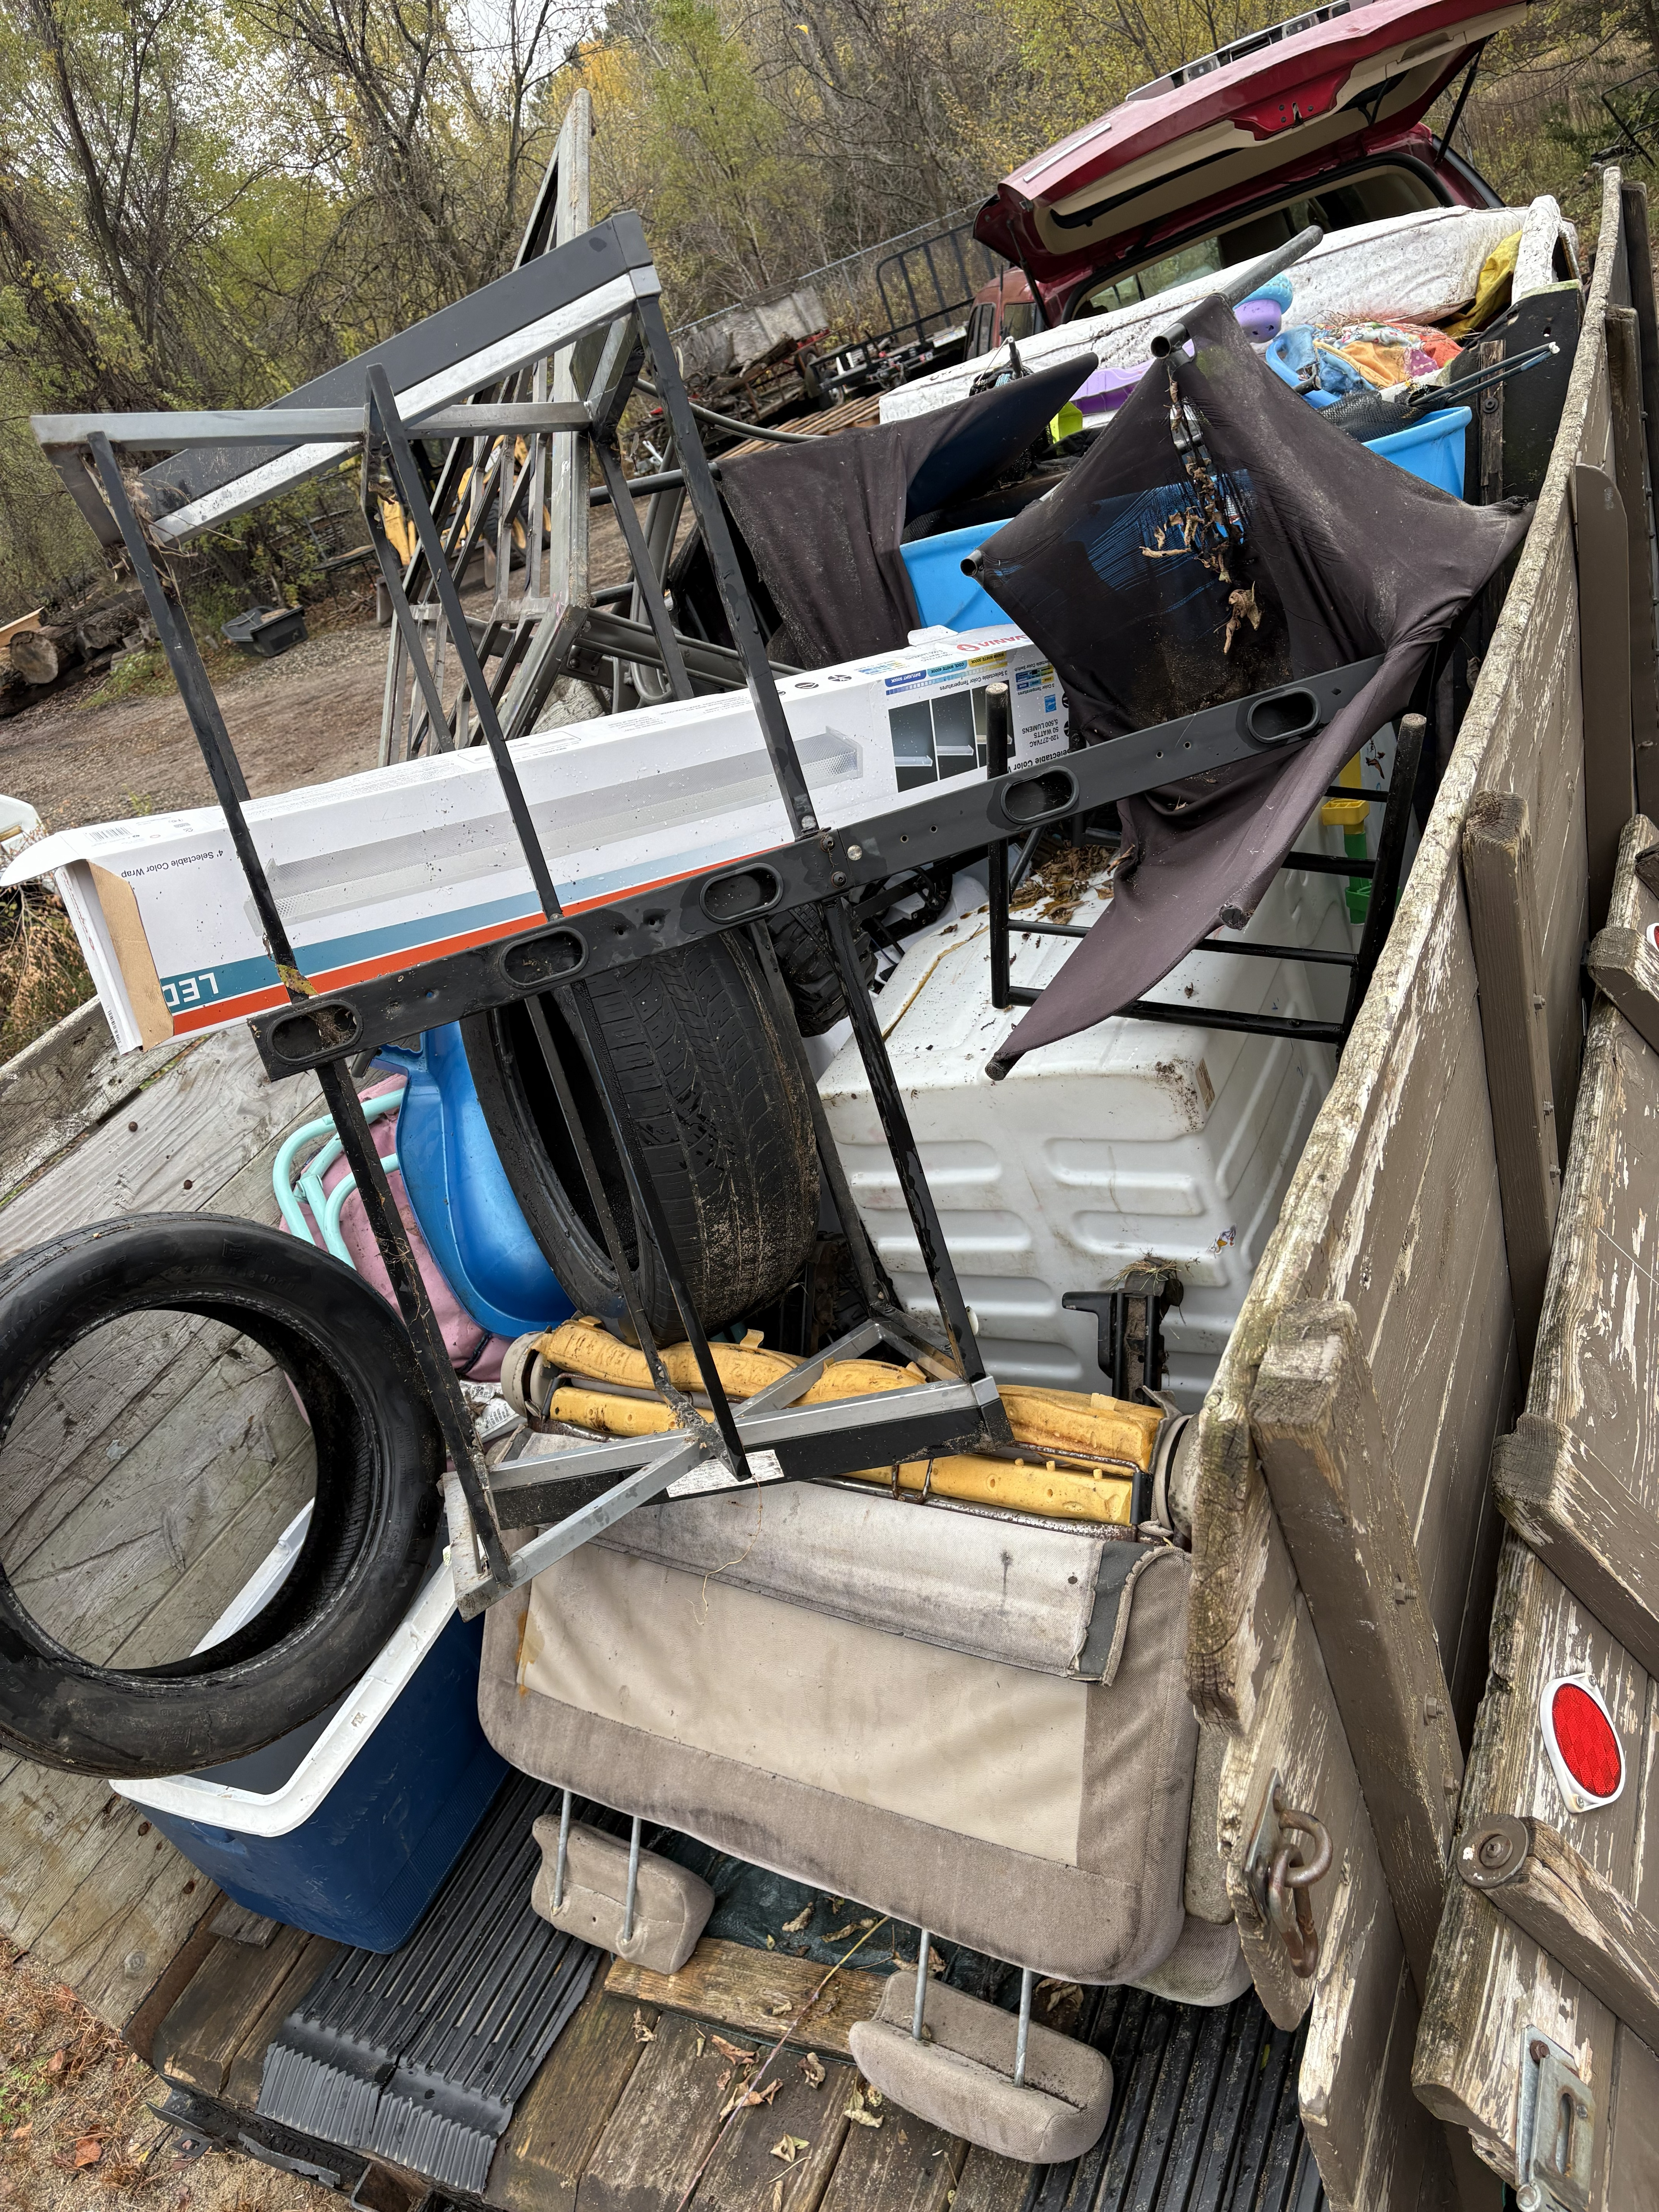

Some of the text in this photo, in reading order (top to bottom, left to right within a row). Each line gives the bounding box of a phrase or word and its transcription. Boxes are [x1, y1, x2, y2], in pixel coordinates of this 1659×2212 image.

[978, 635, 1027, 647] VANIA
[903, 672, 921, 681] DAYLIGHT
[982, 671, 1004, 680] Selectable
[939, 680, 969, 690] Temperatures
[1018, 687, 1041, 695] Temperatures
[1022, 719, 1058, 734] 5,500 LUMENS
[1034, 729, 1052, 738] WATTS
[1029, 734, 1059, 747] 120-277VAC
[1013, 760, 1033, 770] Color
[171, 852, 214, 867] Selectable
[146, 862, 169, 872] Color
[121, 868, 145, 878] Wrap
[161, 972, 219, 1007] LED
[0, 1284, 67, 1350] TIMAX
